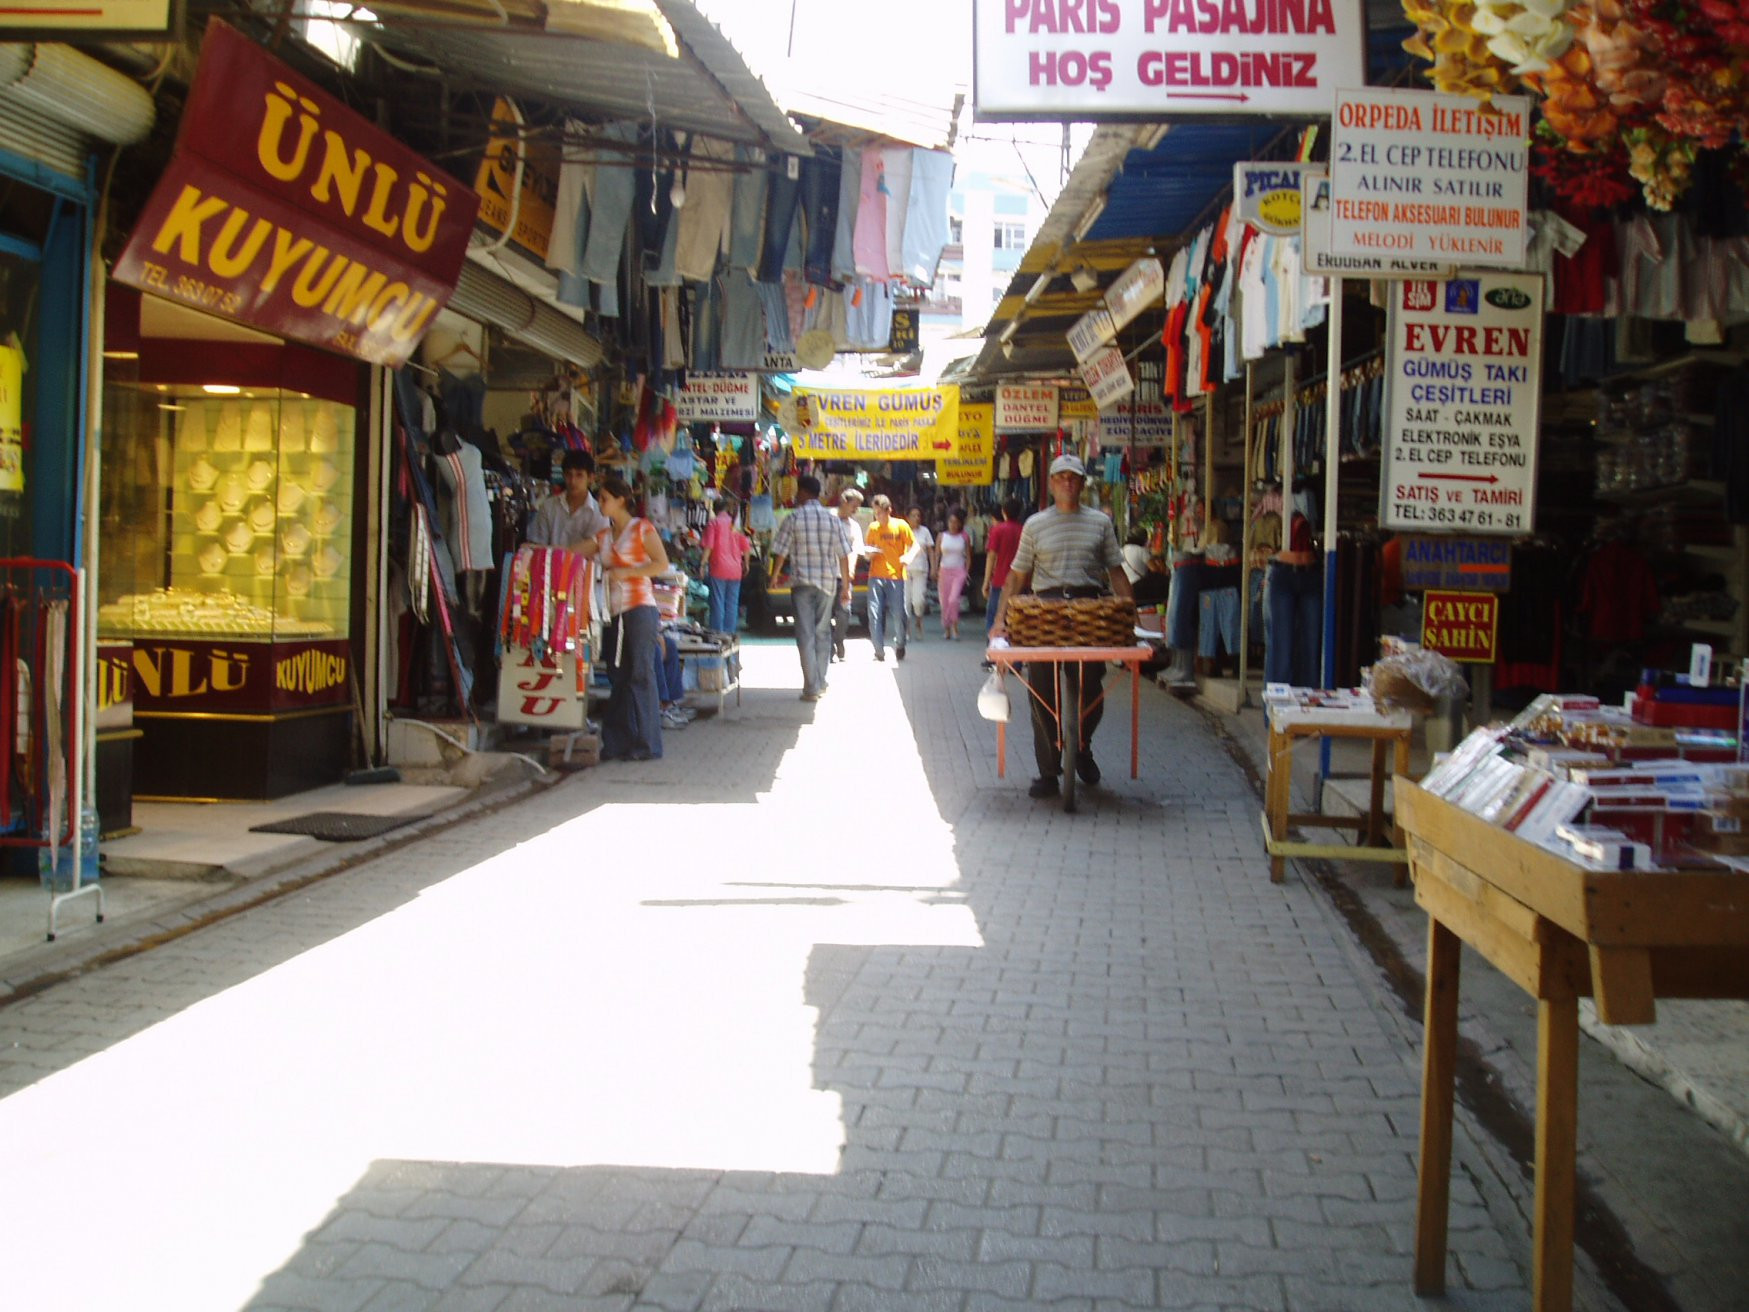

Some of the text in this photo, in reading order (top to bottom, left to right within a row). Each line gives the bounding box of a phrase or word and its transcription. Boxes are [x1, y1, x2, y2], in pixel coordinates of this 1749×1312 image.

[1029, 50, 1113, 91] HOŞ
[1339, 102, 1423, 132] ORPEDA
[258, 80, 447, 253] ÜNLÜ
[1386, 144, 1421, 167] CEP
[1426, 147, 1524, 173] TELEFONU
[1357, 174, 1504, 198] ALINIR SATILIR
[1336, 199, 1520, 230] TELEFON AKSESUARI BULUNUR
[152, 184, 438, 341] KUYUMCU
[1405, 323, 1531, 357] EVREN
[1403, 357, 1528, 383] GÜMÜŞ TAKI
[809, 394, 866, 411] VREN
[1002, 385, 1053, 400] ÖZLEM
[1411, 384, 1512, 406] ÇEŞİTLERİ
[1003, 403, 1049, 413] DANTEL
[1406, 408, 1439, 423] SAAT
[1454, 410, 1512, 427] ÇAKMAK
[809, 432, 848, 450] METRE
[1402, 429, 1521, 449] ELEKTRONİK EŞYA
[1409, 448, 1424, 462] EL
[1427, 449, 1453, 464] CEP
[1461, 451, 1527, 467] TELEFONU
[1396, 485, 1439, 504] SATIŞ
[1446, 490, 1463, 503] VE
[1394, 504, 1425, 520] TEL:
[1428, 506, 1455, 523] 363
[1459, 510, 1474, 525] 47
[1478, 511, 1493, 526] 61
[1505, 514, 1521, 528] 81
[1428, 601, 1490, 626] ÇAYCI
[276, 649, 346, 695] KUYUMCU
